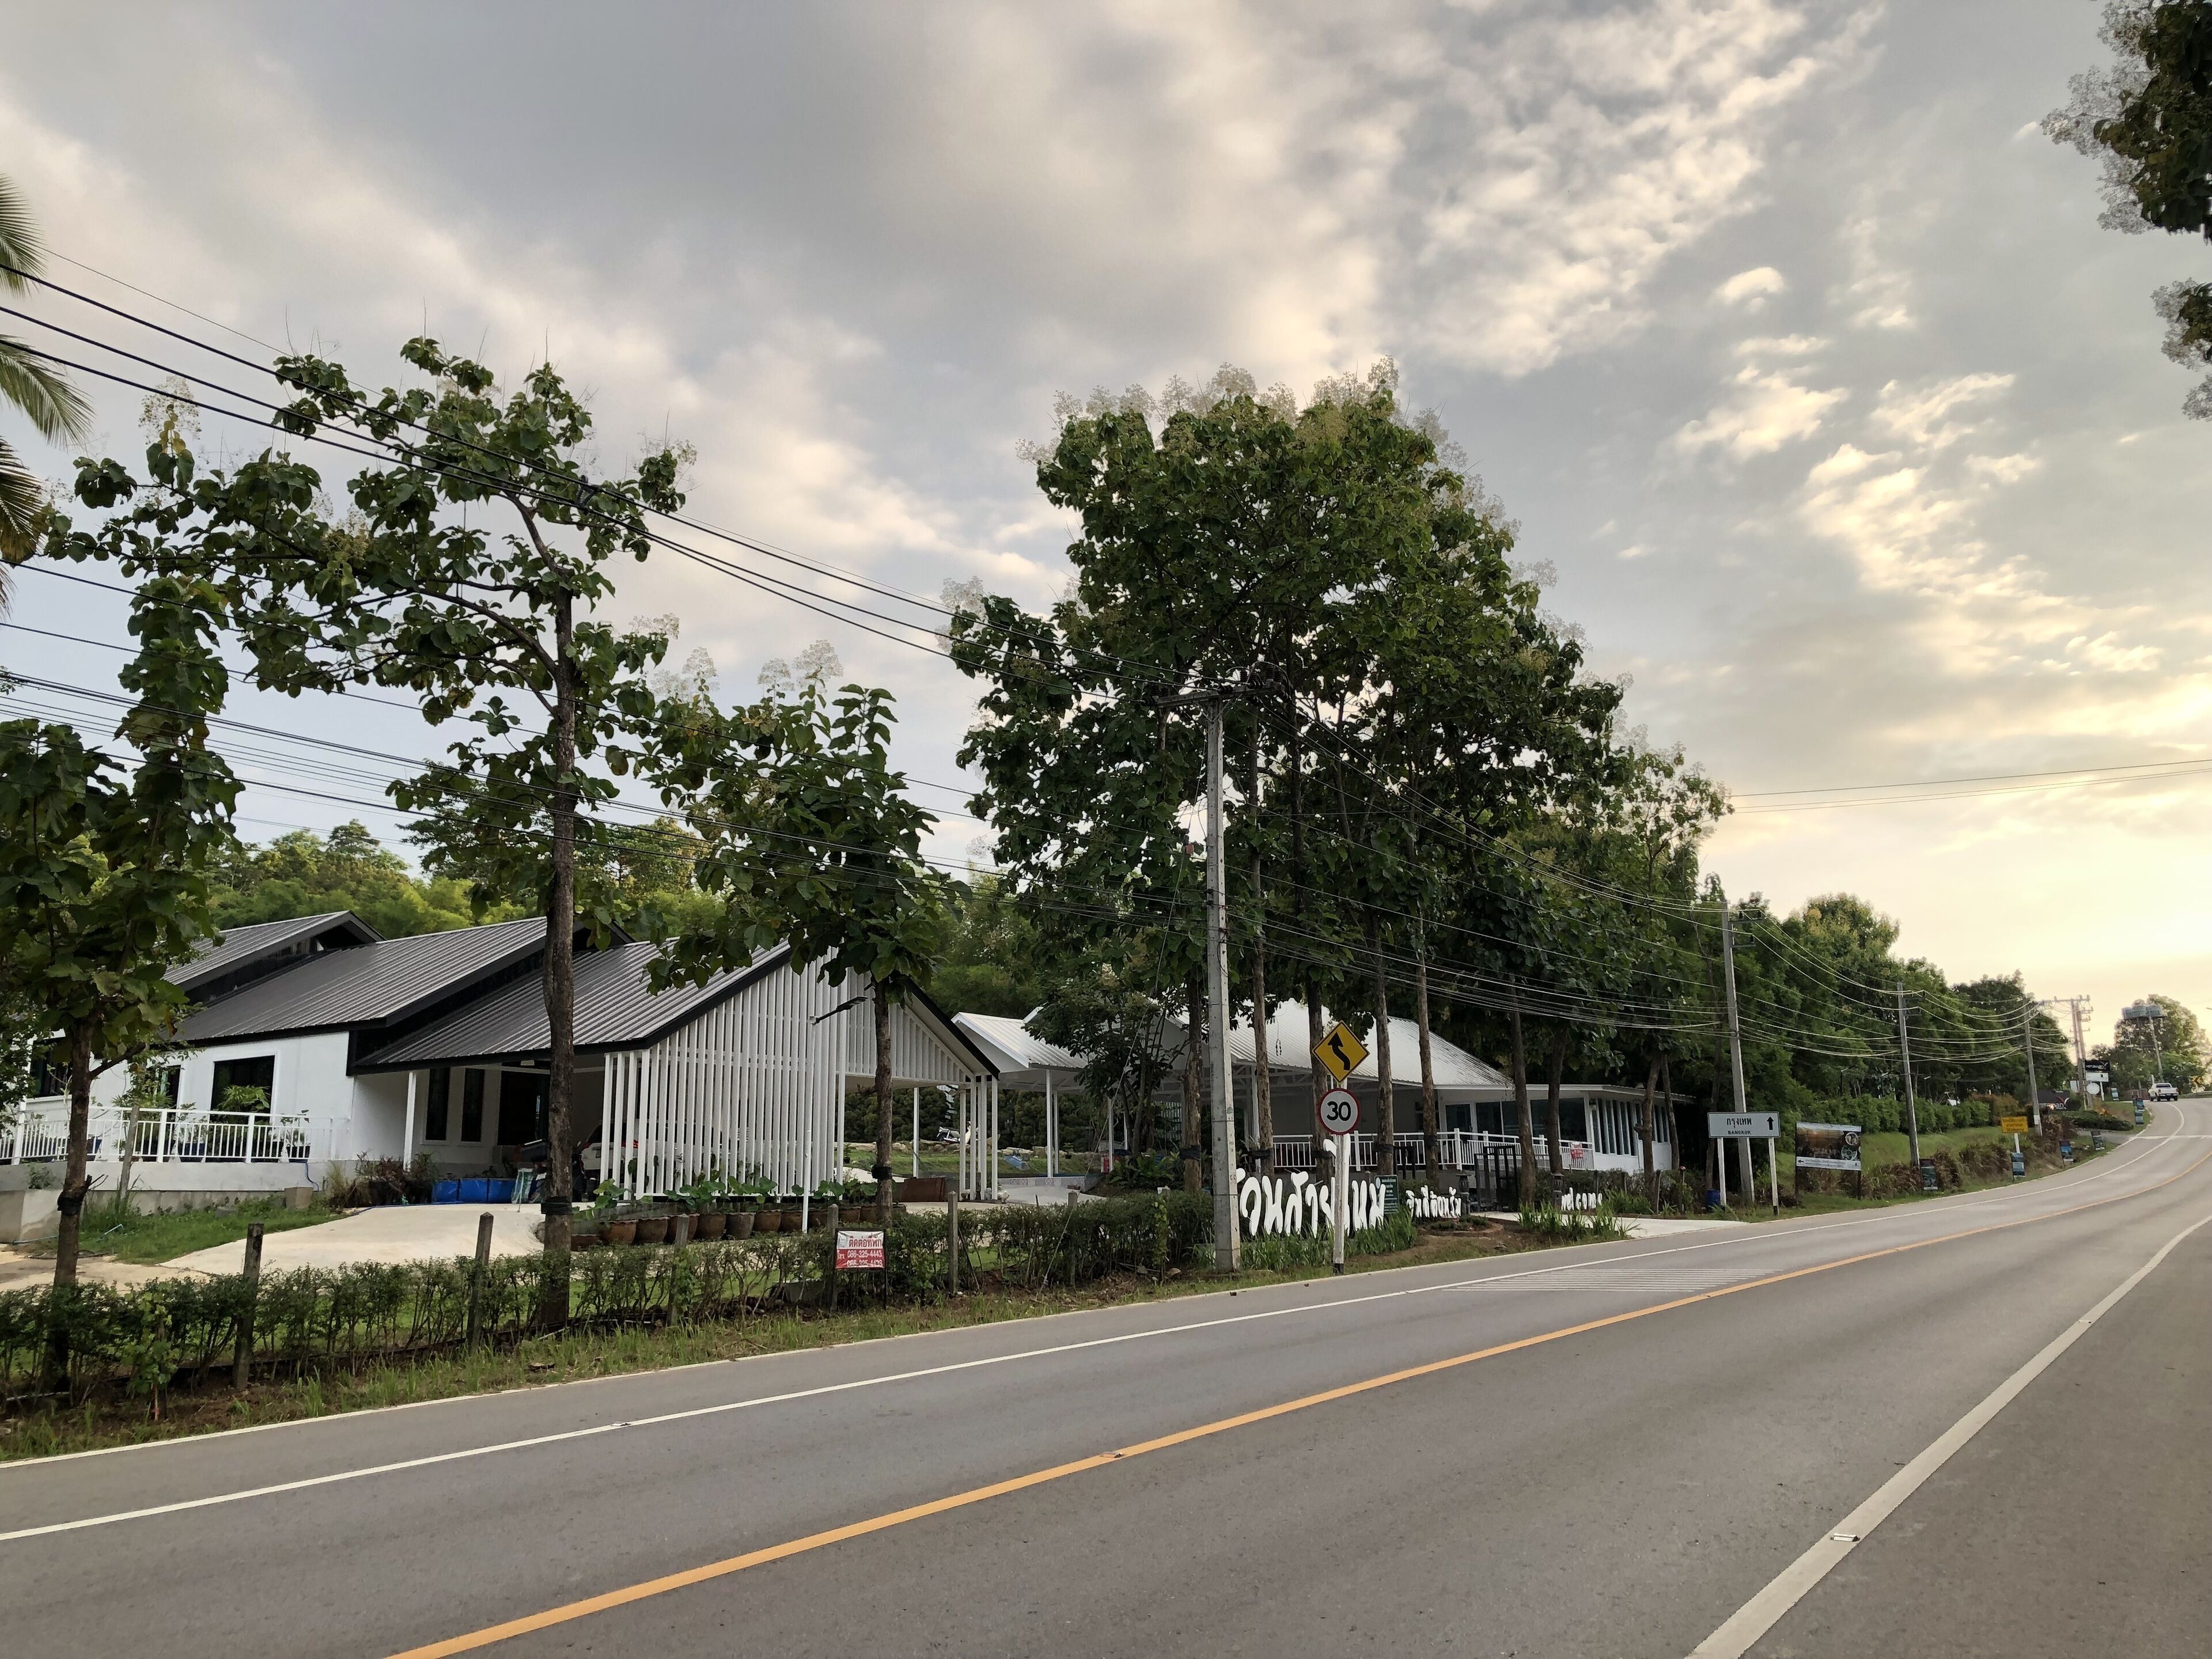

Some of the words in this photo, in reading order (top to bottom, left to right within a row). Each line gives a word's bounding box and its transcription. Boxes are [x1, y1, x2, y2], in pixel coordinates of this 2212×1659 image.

[1327, 1101, 1351, 1122] 30
[1726, 1118, 1752, 1128] กรุงเทพ
[1236, 1133, 1386, 1238] วนสายไหม
[849, 1233, 881, 1247] ติดต่อที่พัก
[847, 1249, 882, 1258] 086-325-4443
